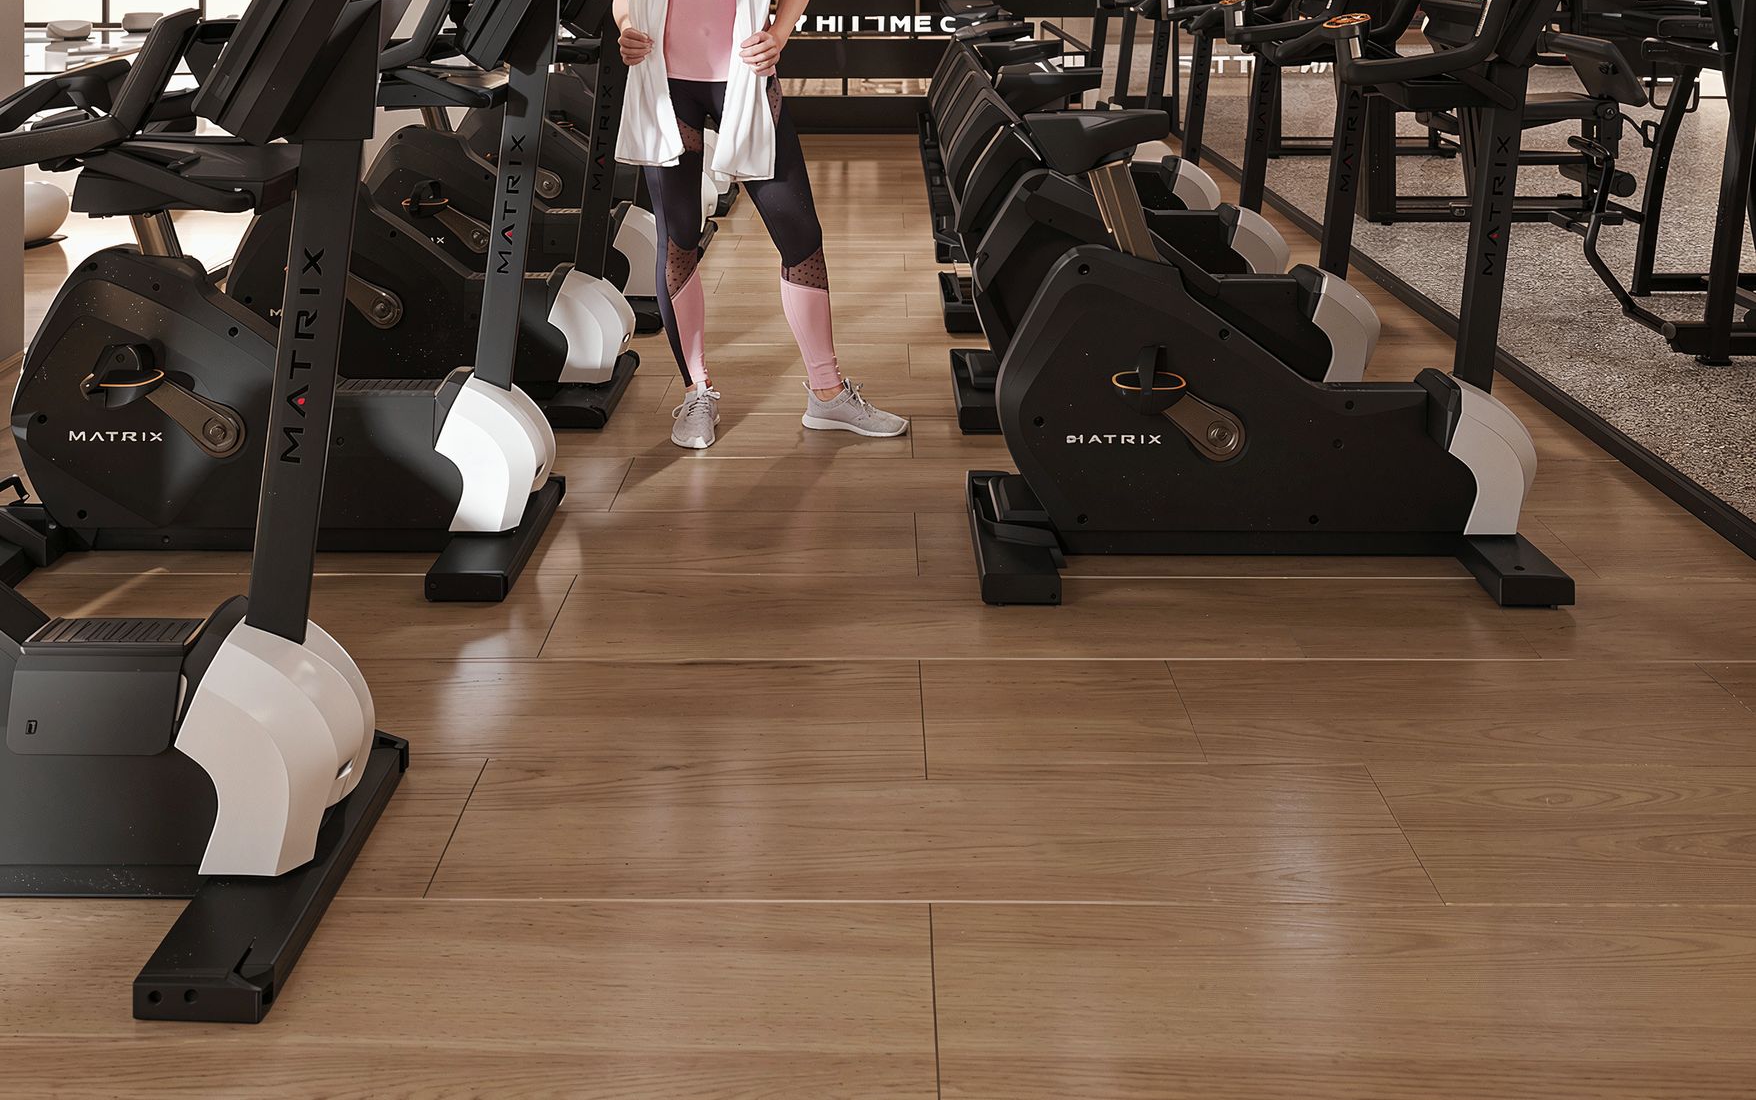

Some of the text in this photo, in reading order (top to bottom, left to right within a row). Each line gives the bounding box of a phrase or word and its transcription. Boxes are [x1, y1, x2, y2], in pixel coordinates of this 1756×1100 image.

[591, 85, 615, 192] MATRIX
[1255, 61, 1273, 142] MATRI
[496, 134, 527, 275] MATRIX
[1482, 136, 1512, 277] MATRIX
[279, 247, 325, 464] MATRIX
[68, 430, 164, 443] MATRIX
